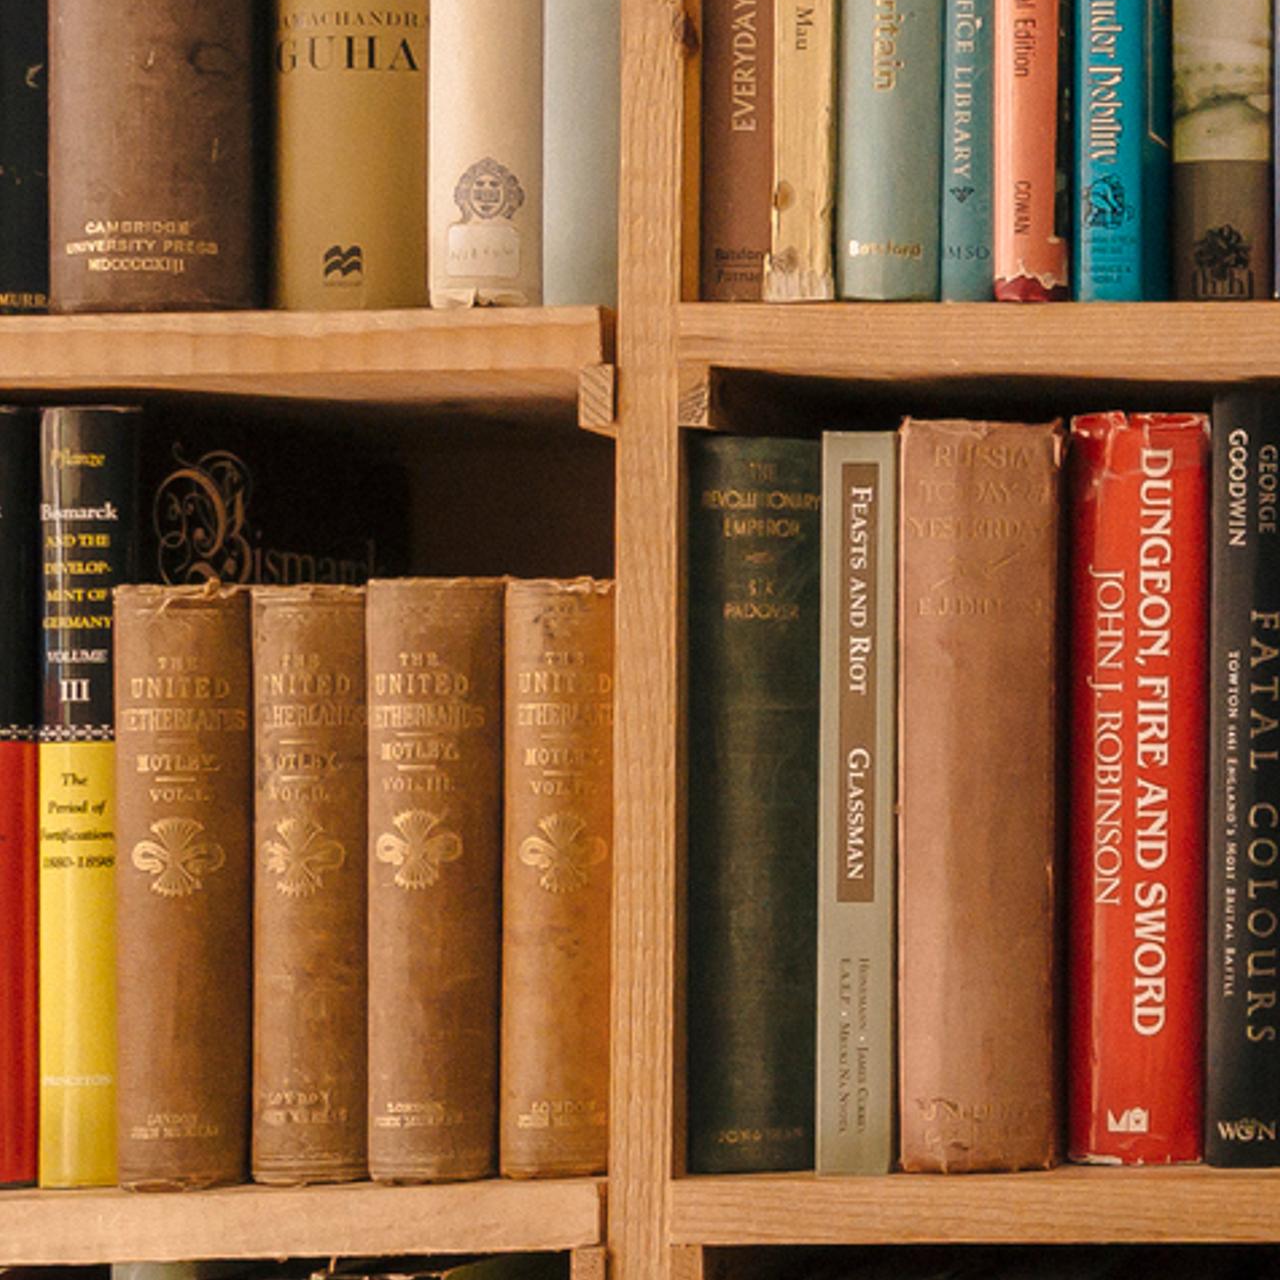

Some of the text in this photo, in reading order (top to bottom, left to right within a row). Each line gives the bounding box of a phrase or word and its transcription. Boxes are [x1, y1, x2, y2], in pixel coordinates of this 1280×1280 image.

[1227, 429, 1249, 547] GOODWIN
[1087, 565, 1125, 904] JOHN J. ROBINSON
[1131, 448, 1173, 1036] DUNGEON, FIRE AND SWORD
[1247, 610, 1280, 1042] FATAL COLOURS
